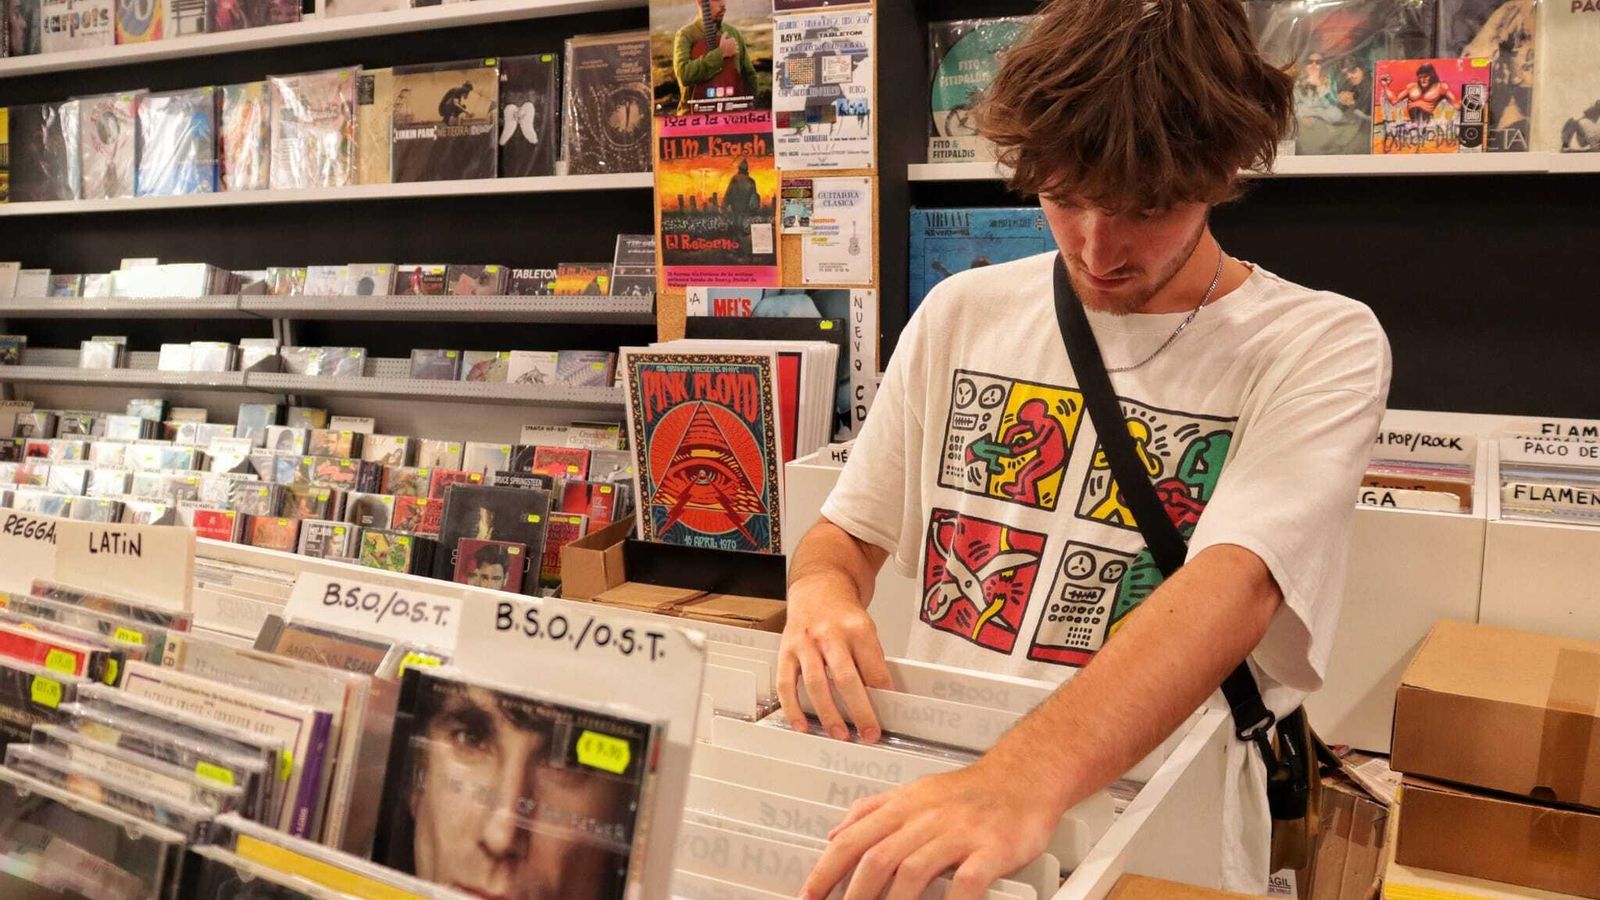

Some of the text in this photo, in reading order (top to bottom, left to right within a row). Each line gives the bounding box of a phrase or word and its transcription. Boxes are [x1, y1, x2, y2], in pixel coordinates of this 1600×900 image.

[705, 114, 718, 125] la
[933, 140, 951, 149] FITO
[641, 369, 759, 424] PINK FLOYD
[1388, 432, 1464, 452] POP/ROCK
[1524, 442, 1599, 458] PACO DE
[2, 514, 57, 544] REGGA
[323, 582, 451, 627] B.S.O./O.S.T.
[495, 602, 666, 662] B.S.O./O.S.T.
